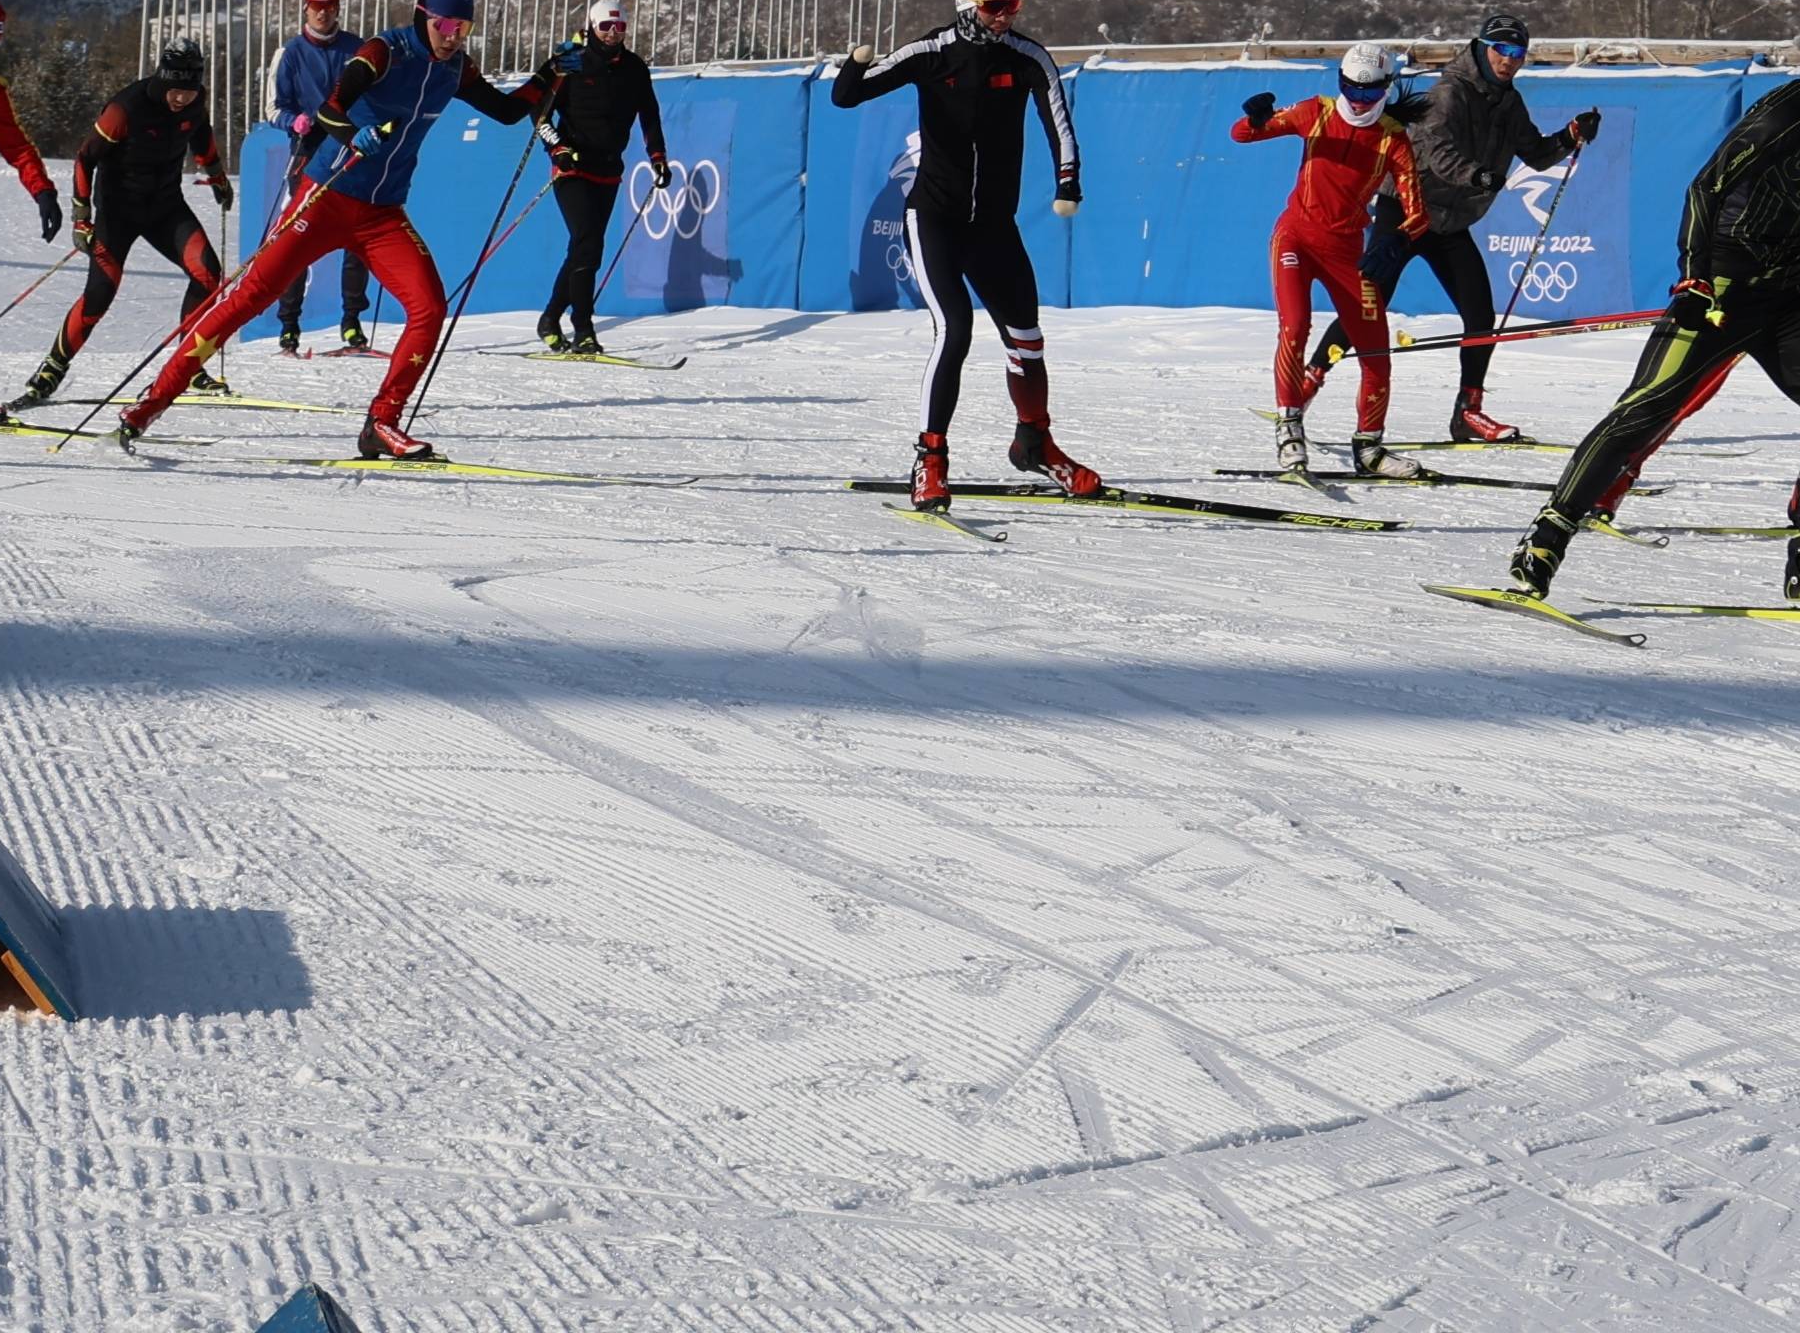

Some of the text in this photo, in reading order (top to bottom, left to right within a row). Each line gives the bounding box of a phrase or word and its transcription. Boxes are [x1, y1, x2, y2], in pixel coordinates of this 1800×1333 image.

[872, 219, 904, 241] BEIJI
[1549, 235, 1596, 253] 2022
[390, 461, 449, 471] FISCHER
[1062, 498, 1127, 509] FISCHER
[1278, 512, 1386, 532] FISCHER
